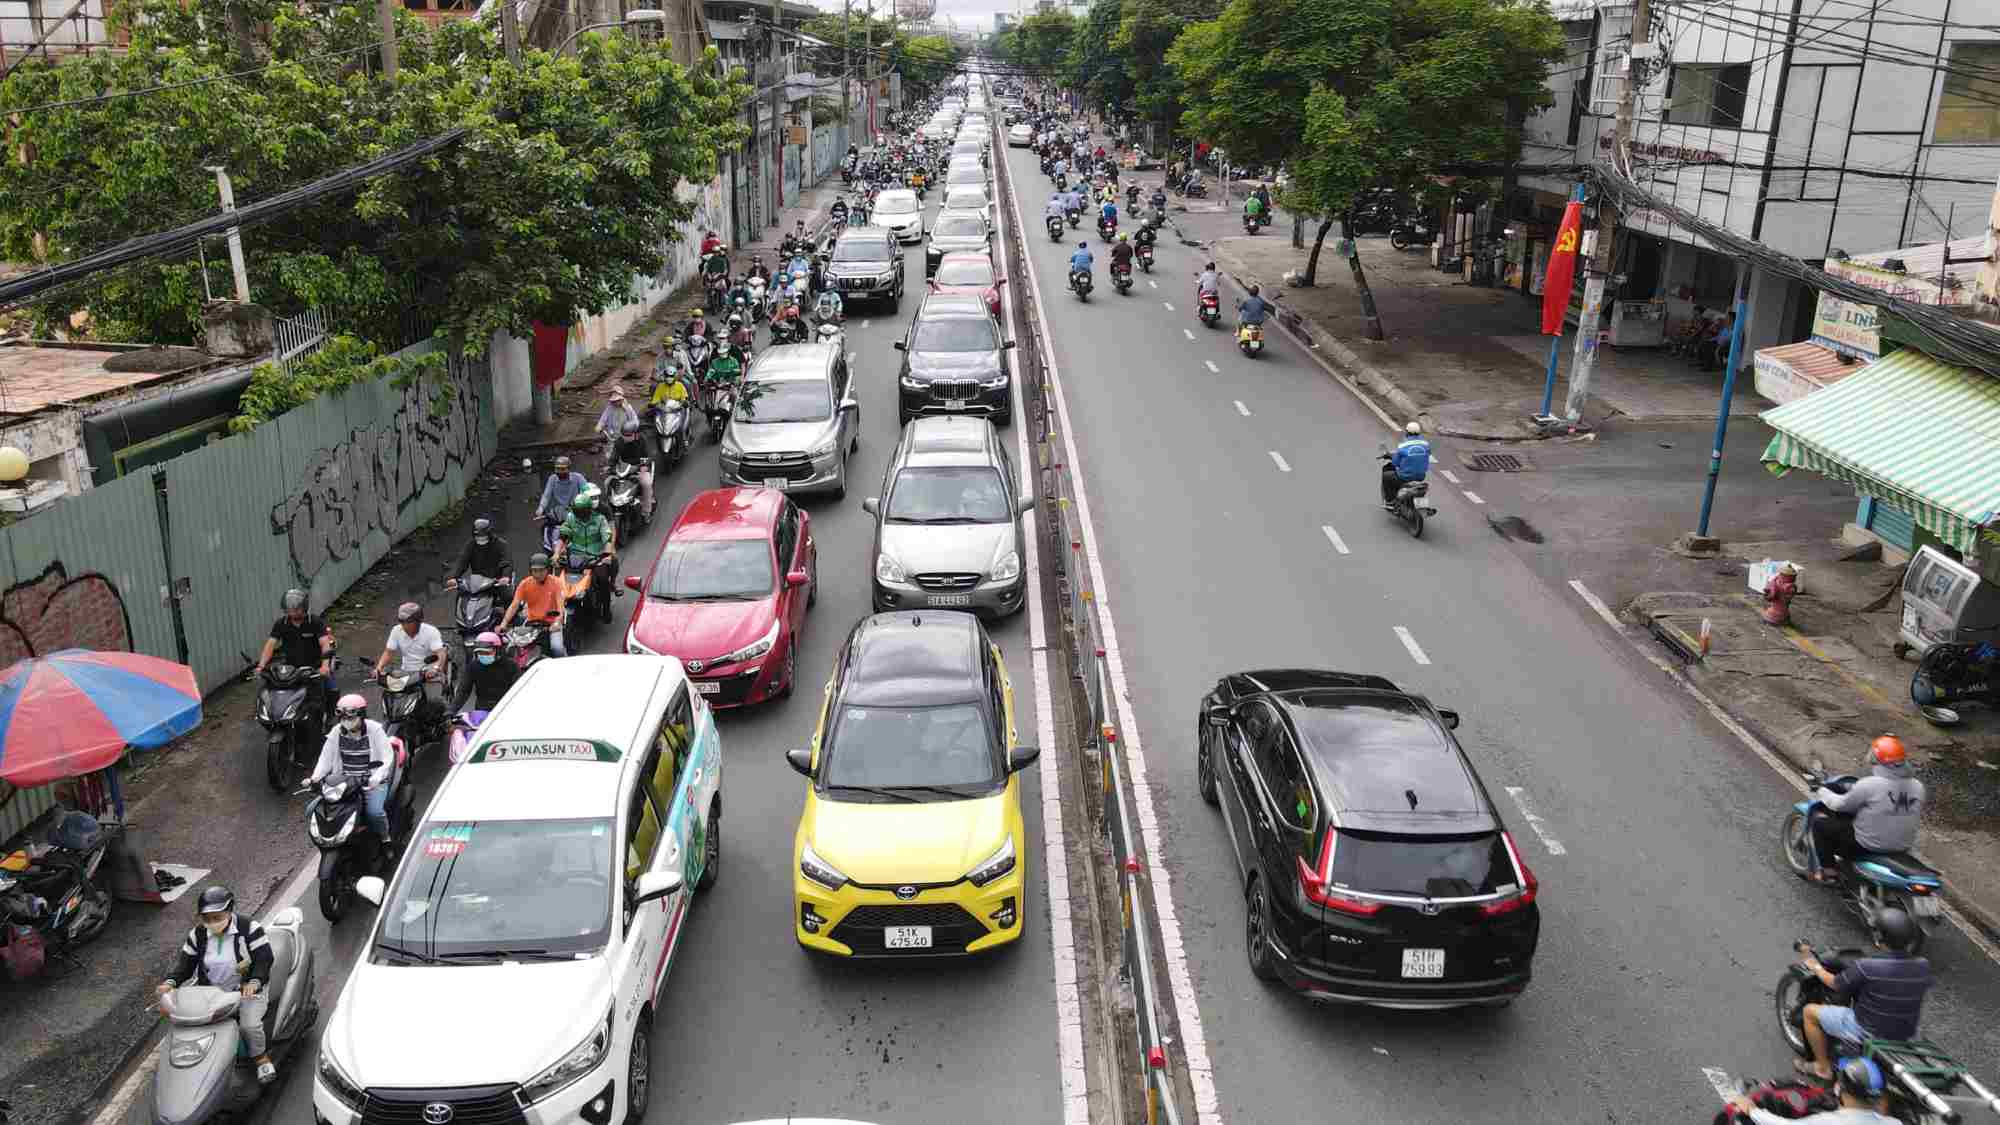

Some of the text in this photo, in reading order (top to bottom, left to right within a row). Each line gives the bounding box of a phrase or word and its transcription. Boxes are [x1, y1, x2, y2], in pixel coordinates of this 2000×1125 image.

[511, 743, 593, 755] VINASUN TAXI
[896, 928, 918, 937] 51K
